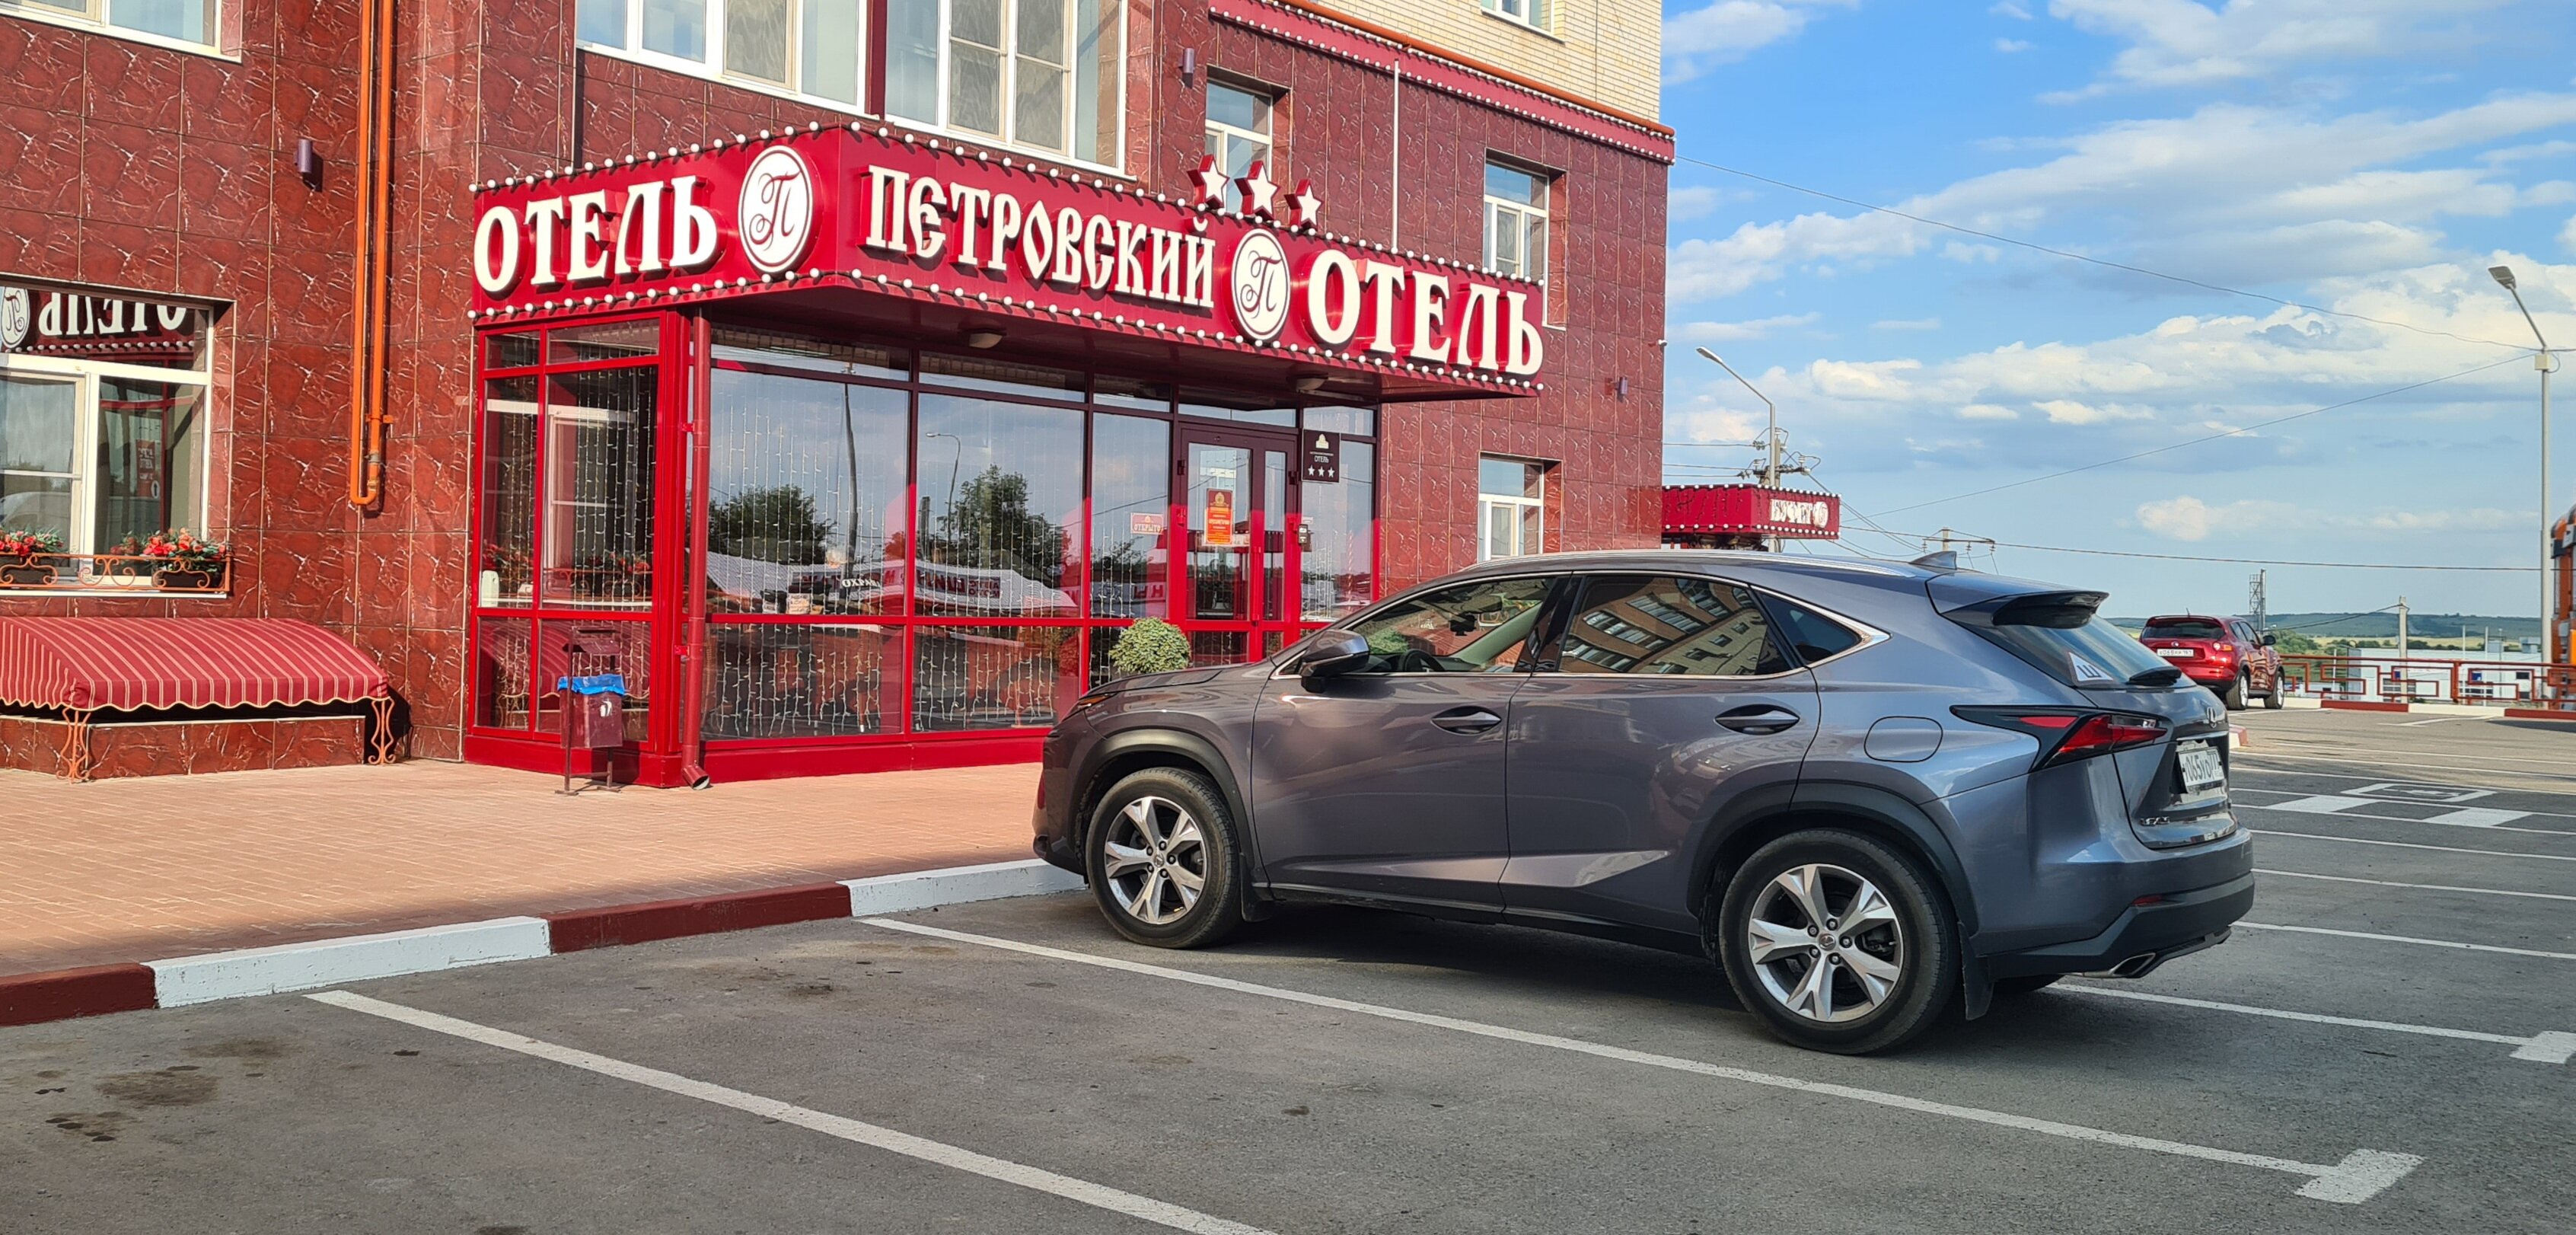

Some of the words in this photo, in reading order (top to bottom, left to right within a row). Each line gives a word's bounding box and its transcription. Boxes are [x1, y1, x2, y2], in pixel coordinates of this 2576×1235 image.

[473, 175, 718, 292] ОТЕЛЬ
[866, 164, 1215, 308] ПЕТРОВСКИЙ
[1308, 249, 1543, 375] ОТЕЛЬ
[1133, 523, 1161, 532] ОТКРЫТО
